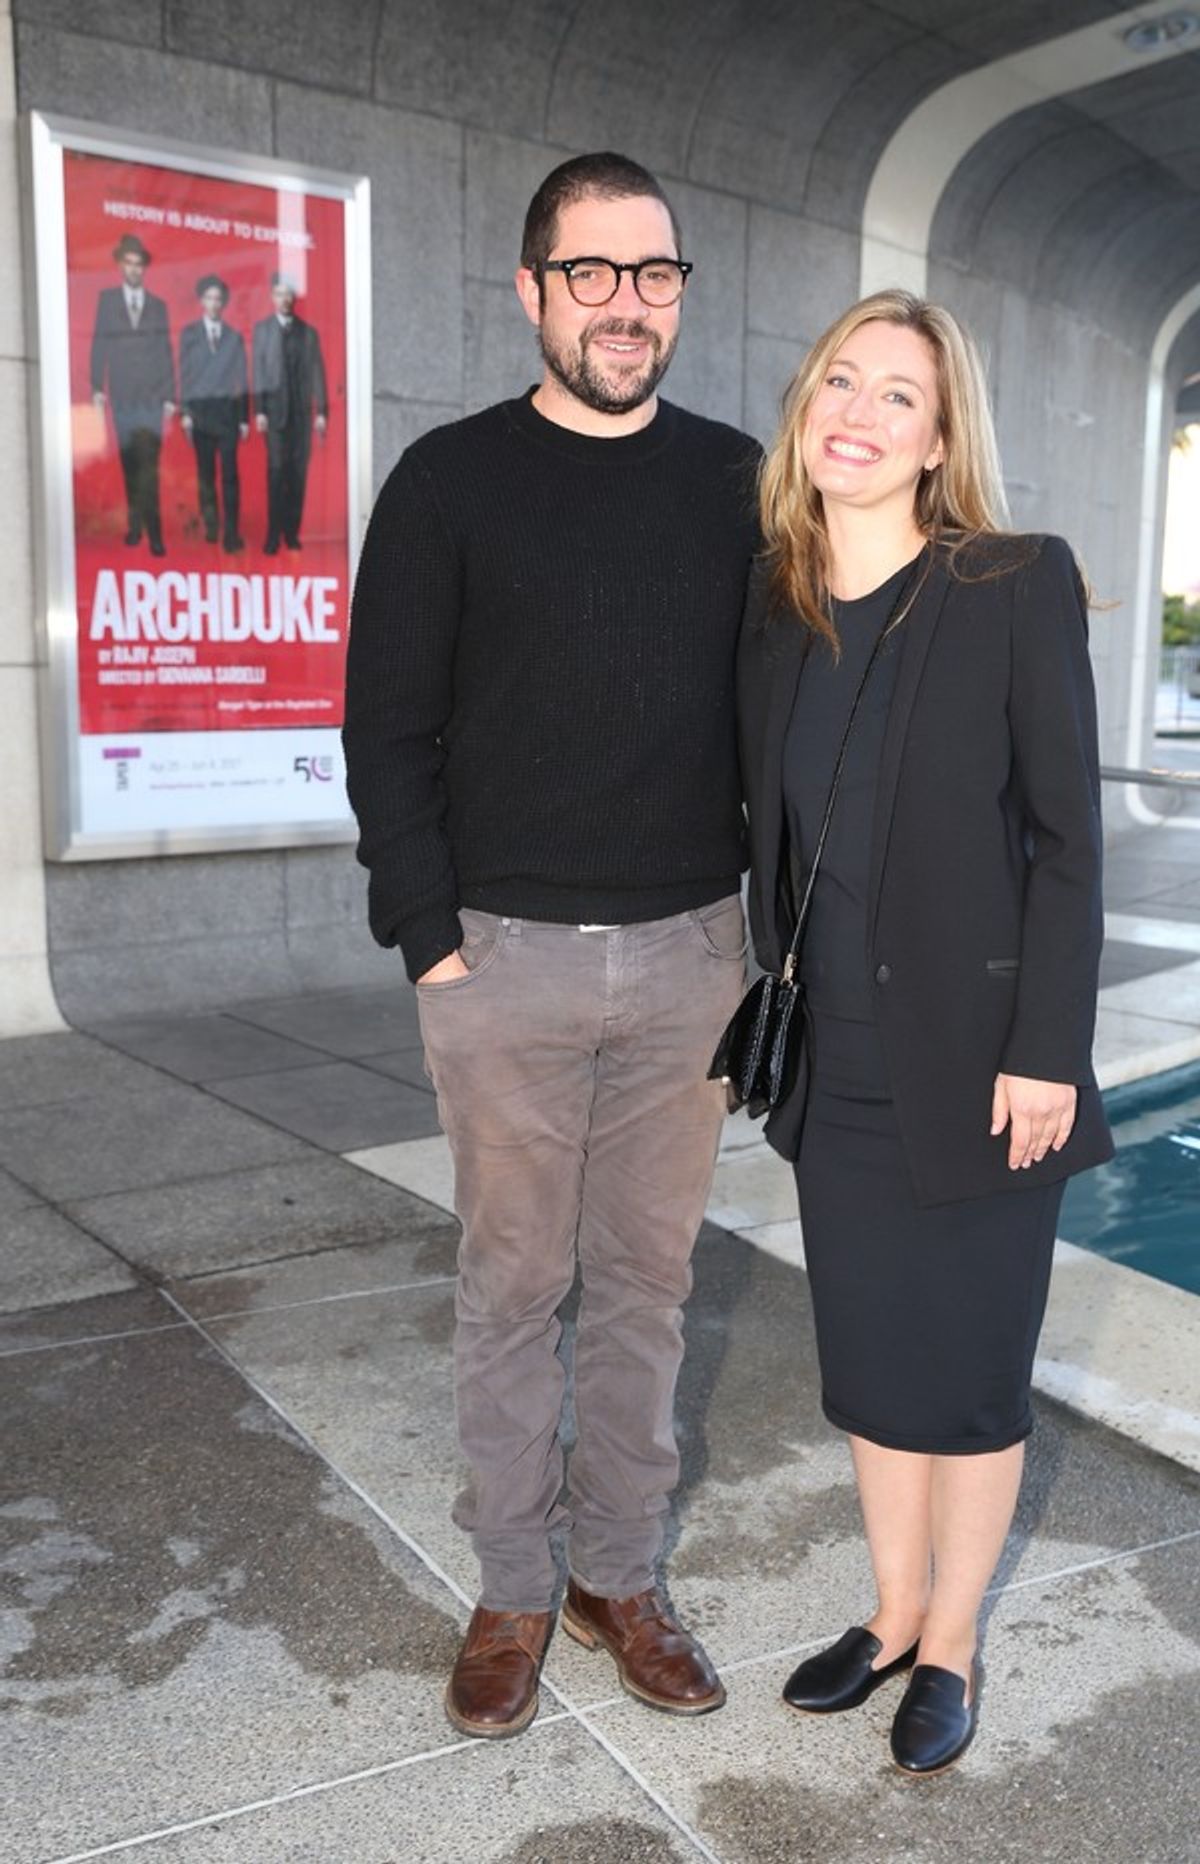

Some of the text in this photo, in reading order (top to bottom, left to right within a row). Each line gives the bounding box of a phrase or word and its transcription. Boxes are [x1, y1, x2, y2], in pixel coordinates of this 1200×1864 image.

[104, 201, 164, 224] HISTORY
[167, 210, 182, 228] IS
[184, 213, 229, 235] ABOUT
[234, 221, 252, 239] TO
[90, 570, 339, 643] ARCHDUKE
